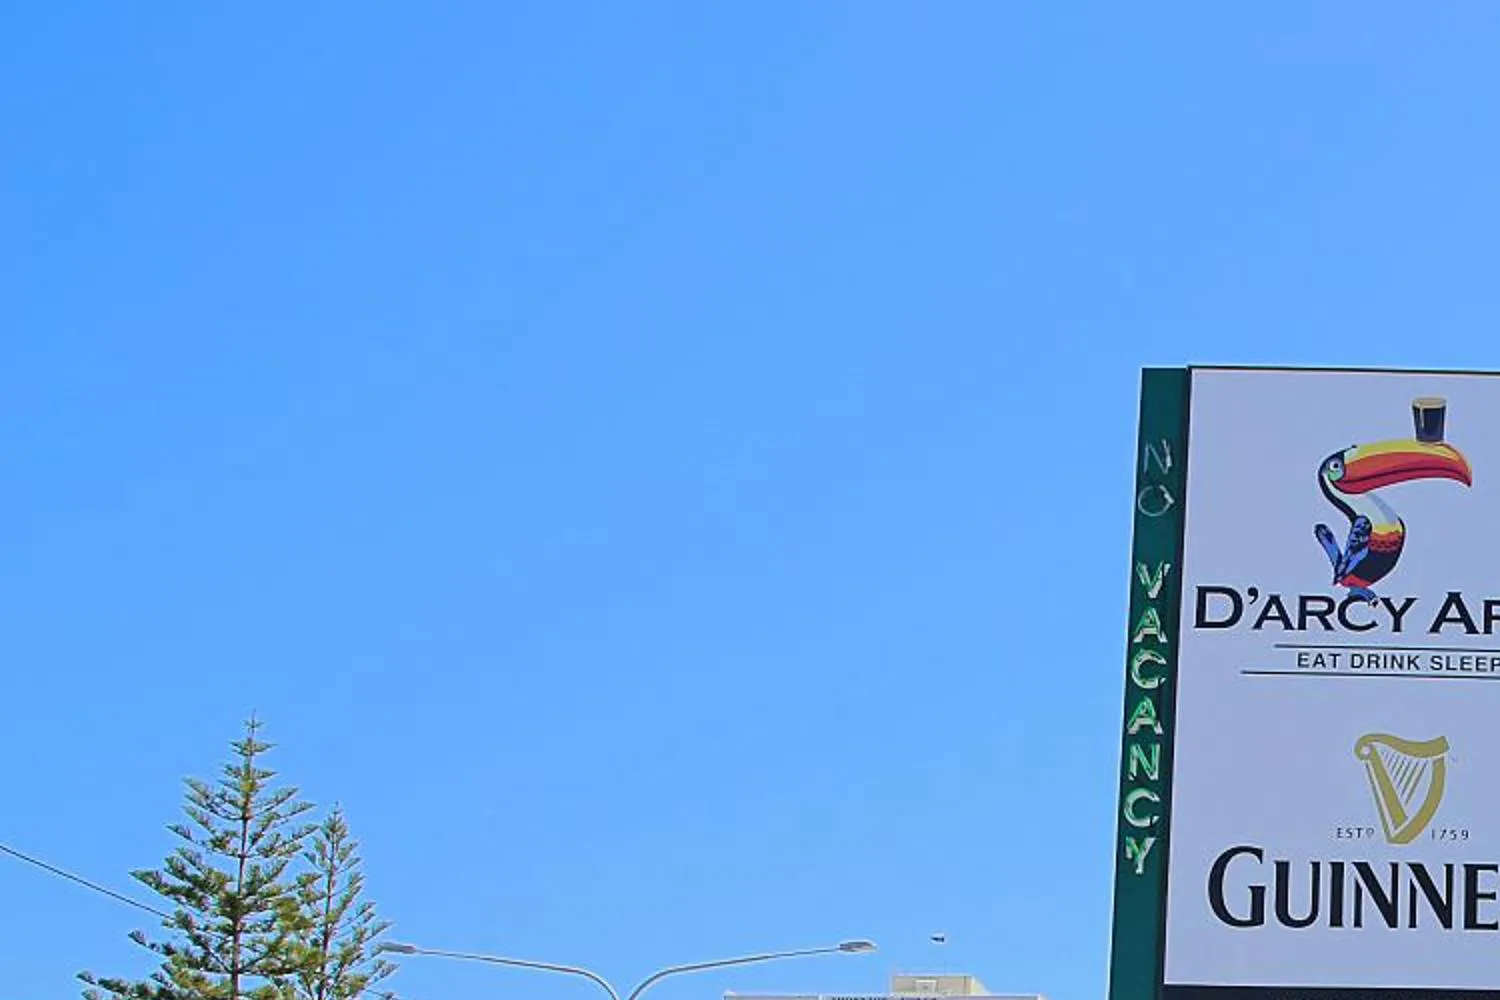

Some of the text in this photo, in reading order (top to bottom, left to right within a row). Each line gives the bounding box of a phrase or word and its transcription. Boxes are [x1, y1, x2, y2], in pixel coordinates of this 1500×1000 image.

[1194, 585, 1417, 633] D'ARCY
[1123, 438, 1175, 875] NO VACANCY
[1297, 652, 1342, 669] EAT
[1350, 653, 1420, 670] DRINK
[1431, 829, 1469, 841] 1759
